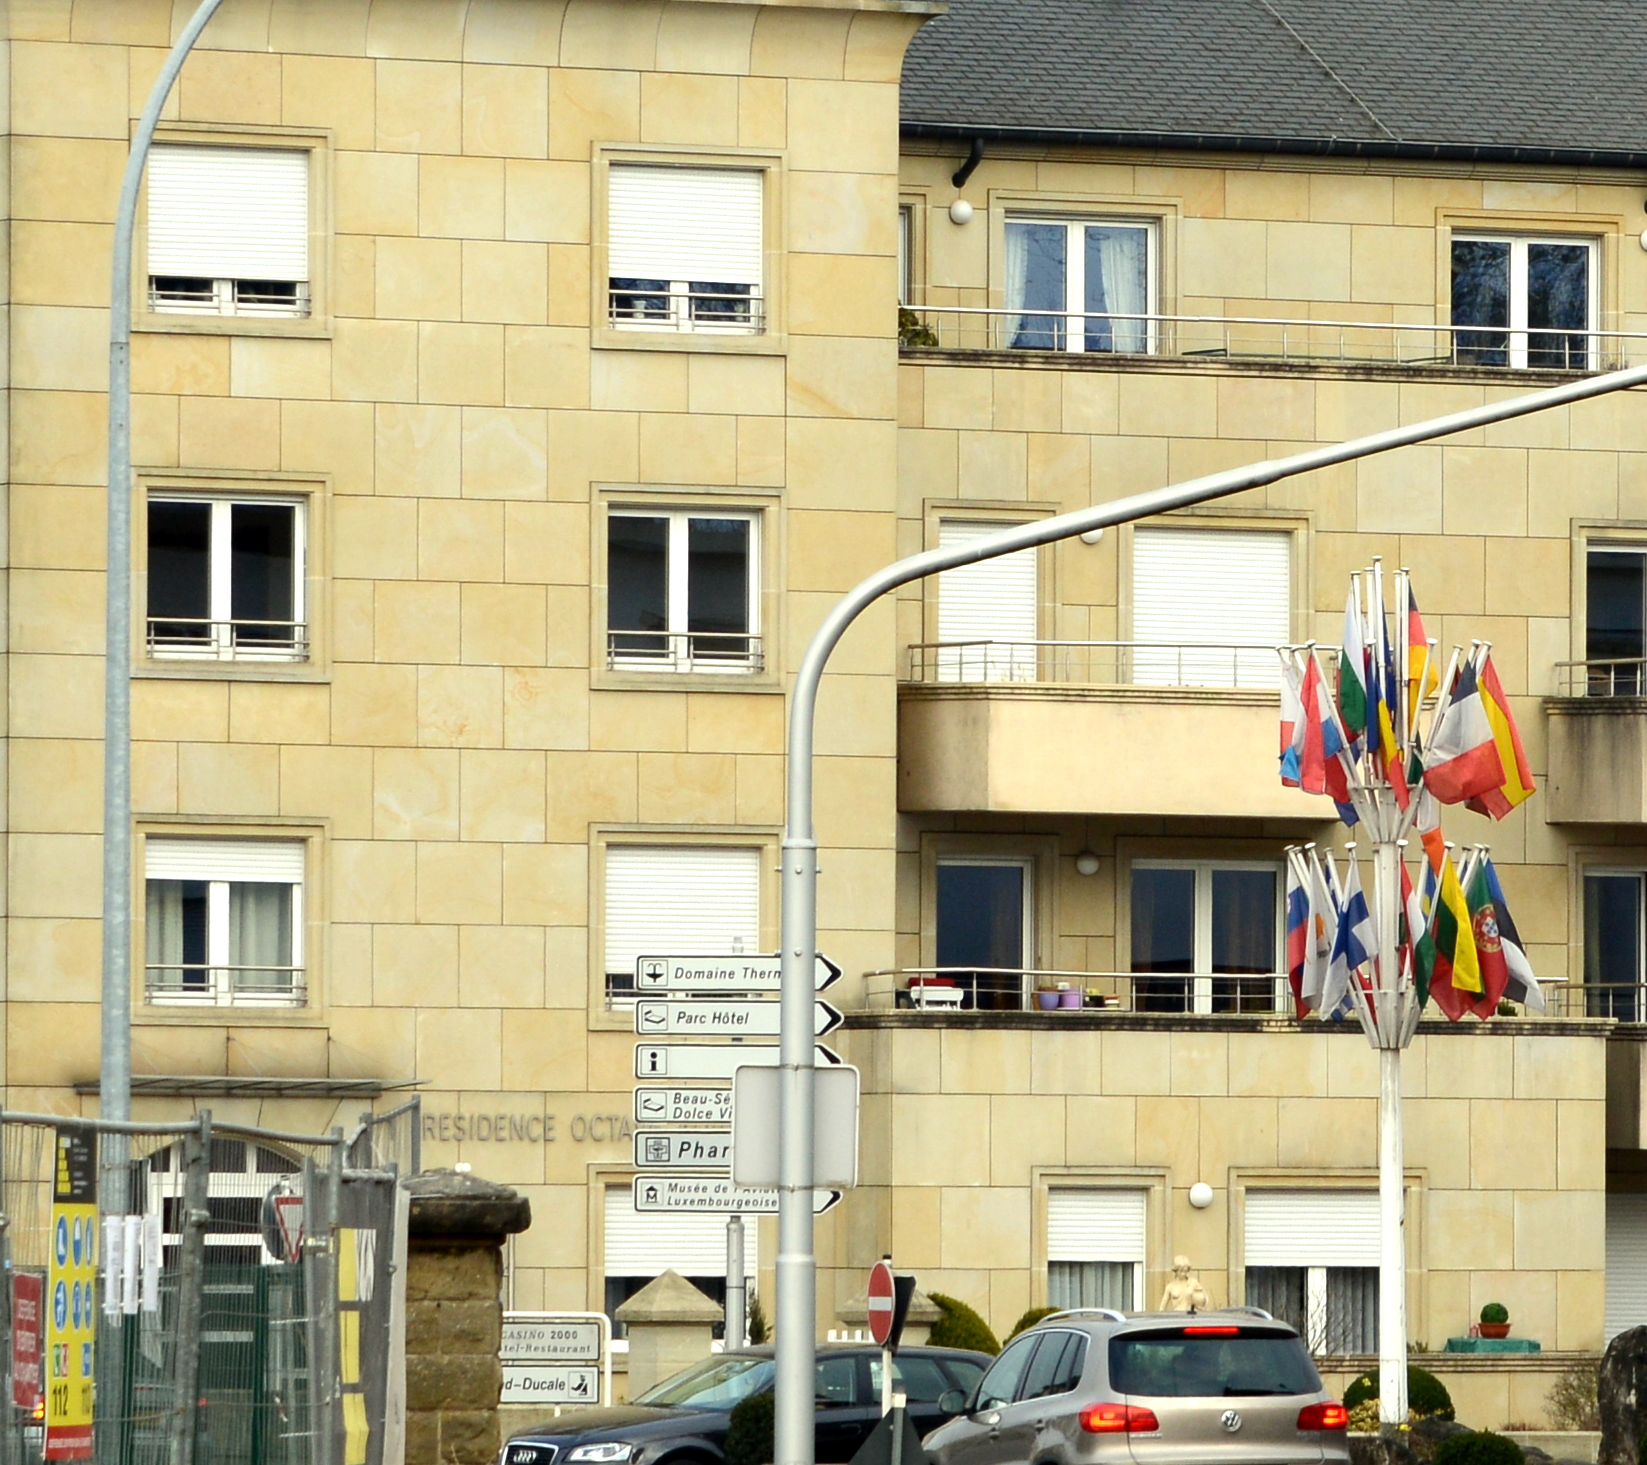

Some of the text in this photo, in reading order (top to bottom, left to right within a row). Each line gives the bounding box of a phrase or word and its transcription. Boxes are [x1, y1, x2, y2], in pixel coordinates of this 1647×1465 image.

[674, 966, 736, 980] Domaine
[676, 1010, 750, 1025] Parc Hôtel
[672, 1091, 731, 1105] Beau-Sé
[672, 1106, 732, 1120] Dolce Vi
[421, 1112, 634, 1143] RESIDENCE OCTA
[677, 1140, 731, 1159] Phar
[667, 1181, 708, 1194] Musée
[714, 1182, 728, 1194] de
[667, 1195, 778, 1210] Luxembourgeoise
[550, 1330, 578, 1340] 2000
[504, 1343, 592, 1354] tel-Restaurant
[502, 1376, 566, 1391] d-Ducale
[52, 1384, 69, 1417] 112
